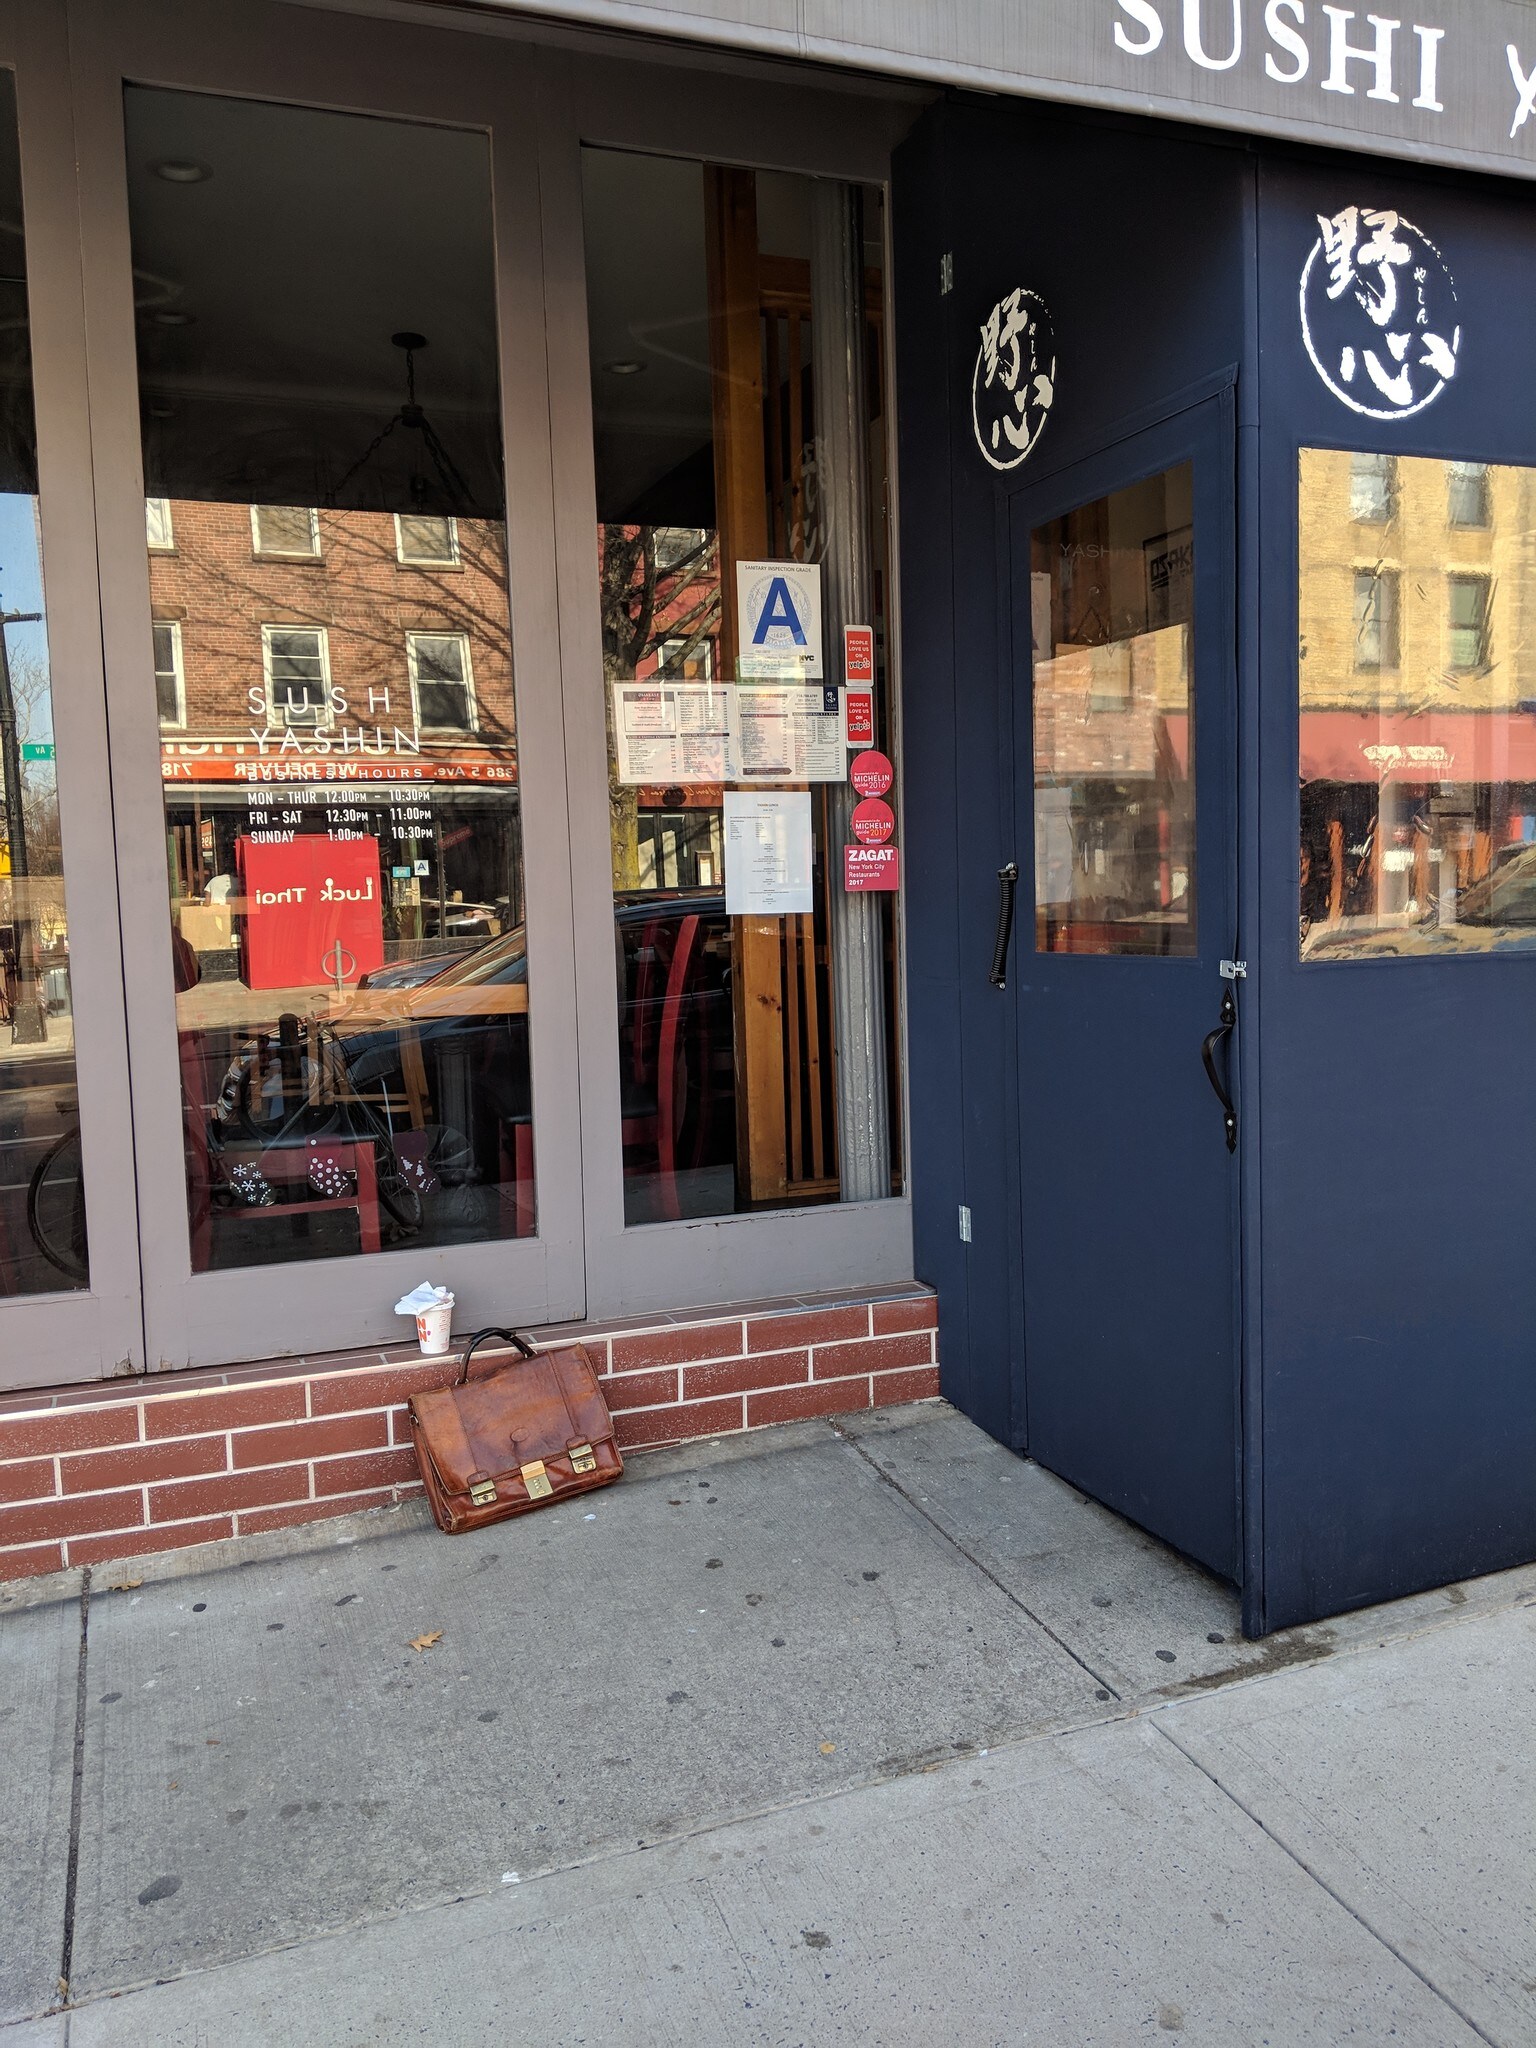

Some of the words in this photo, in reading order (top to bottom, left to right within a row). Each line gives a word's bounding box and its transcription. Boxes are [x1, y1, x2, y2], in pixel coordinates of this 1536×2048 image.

[1114, 0, 1445, 112] SUSHI
[752, 577, 808, 645] A
[849, 661, 863, 669] yelp
[849, 722, 863, 731] yelp
[249, 726, 420, 755] YASHIN
[248, 769, 347, 781] BUSINESS
[358, 768, 422, 779] HOURS
[854, 774, 890, 782] MICHELIN
[247, 792, 274, 805] MON
[287, 791, 317, 804] THUR
[325, 790, 367, 803] 12:00PM
[388, 788, 430, 801] 10:30PM
[249, 811, 268, 824] FRI
[282, 810, 302, 824] SAT
[325, 809, 369, 822] 12:30PM
[389, 807, 431, 820] 11:00PM
[251, 830, 295, 844] SUNDAY
[327, 828, 363, 841] 1:00PM
[391, 826, 433, 839] 10:30PM
